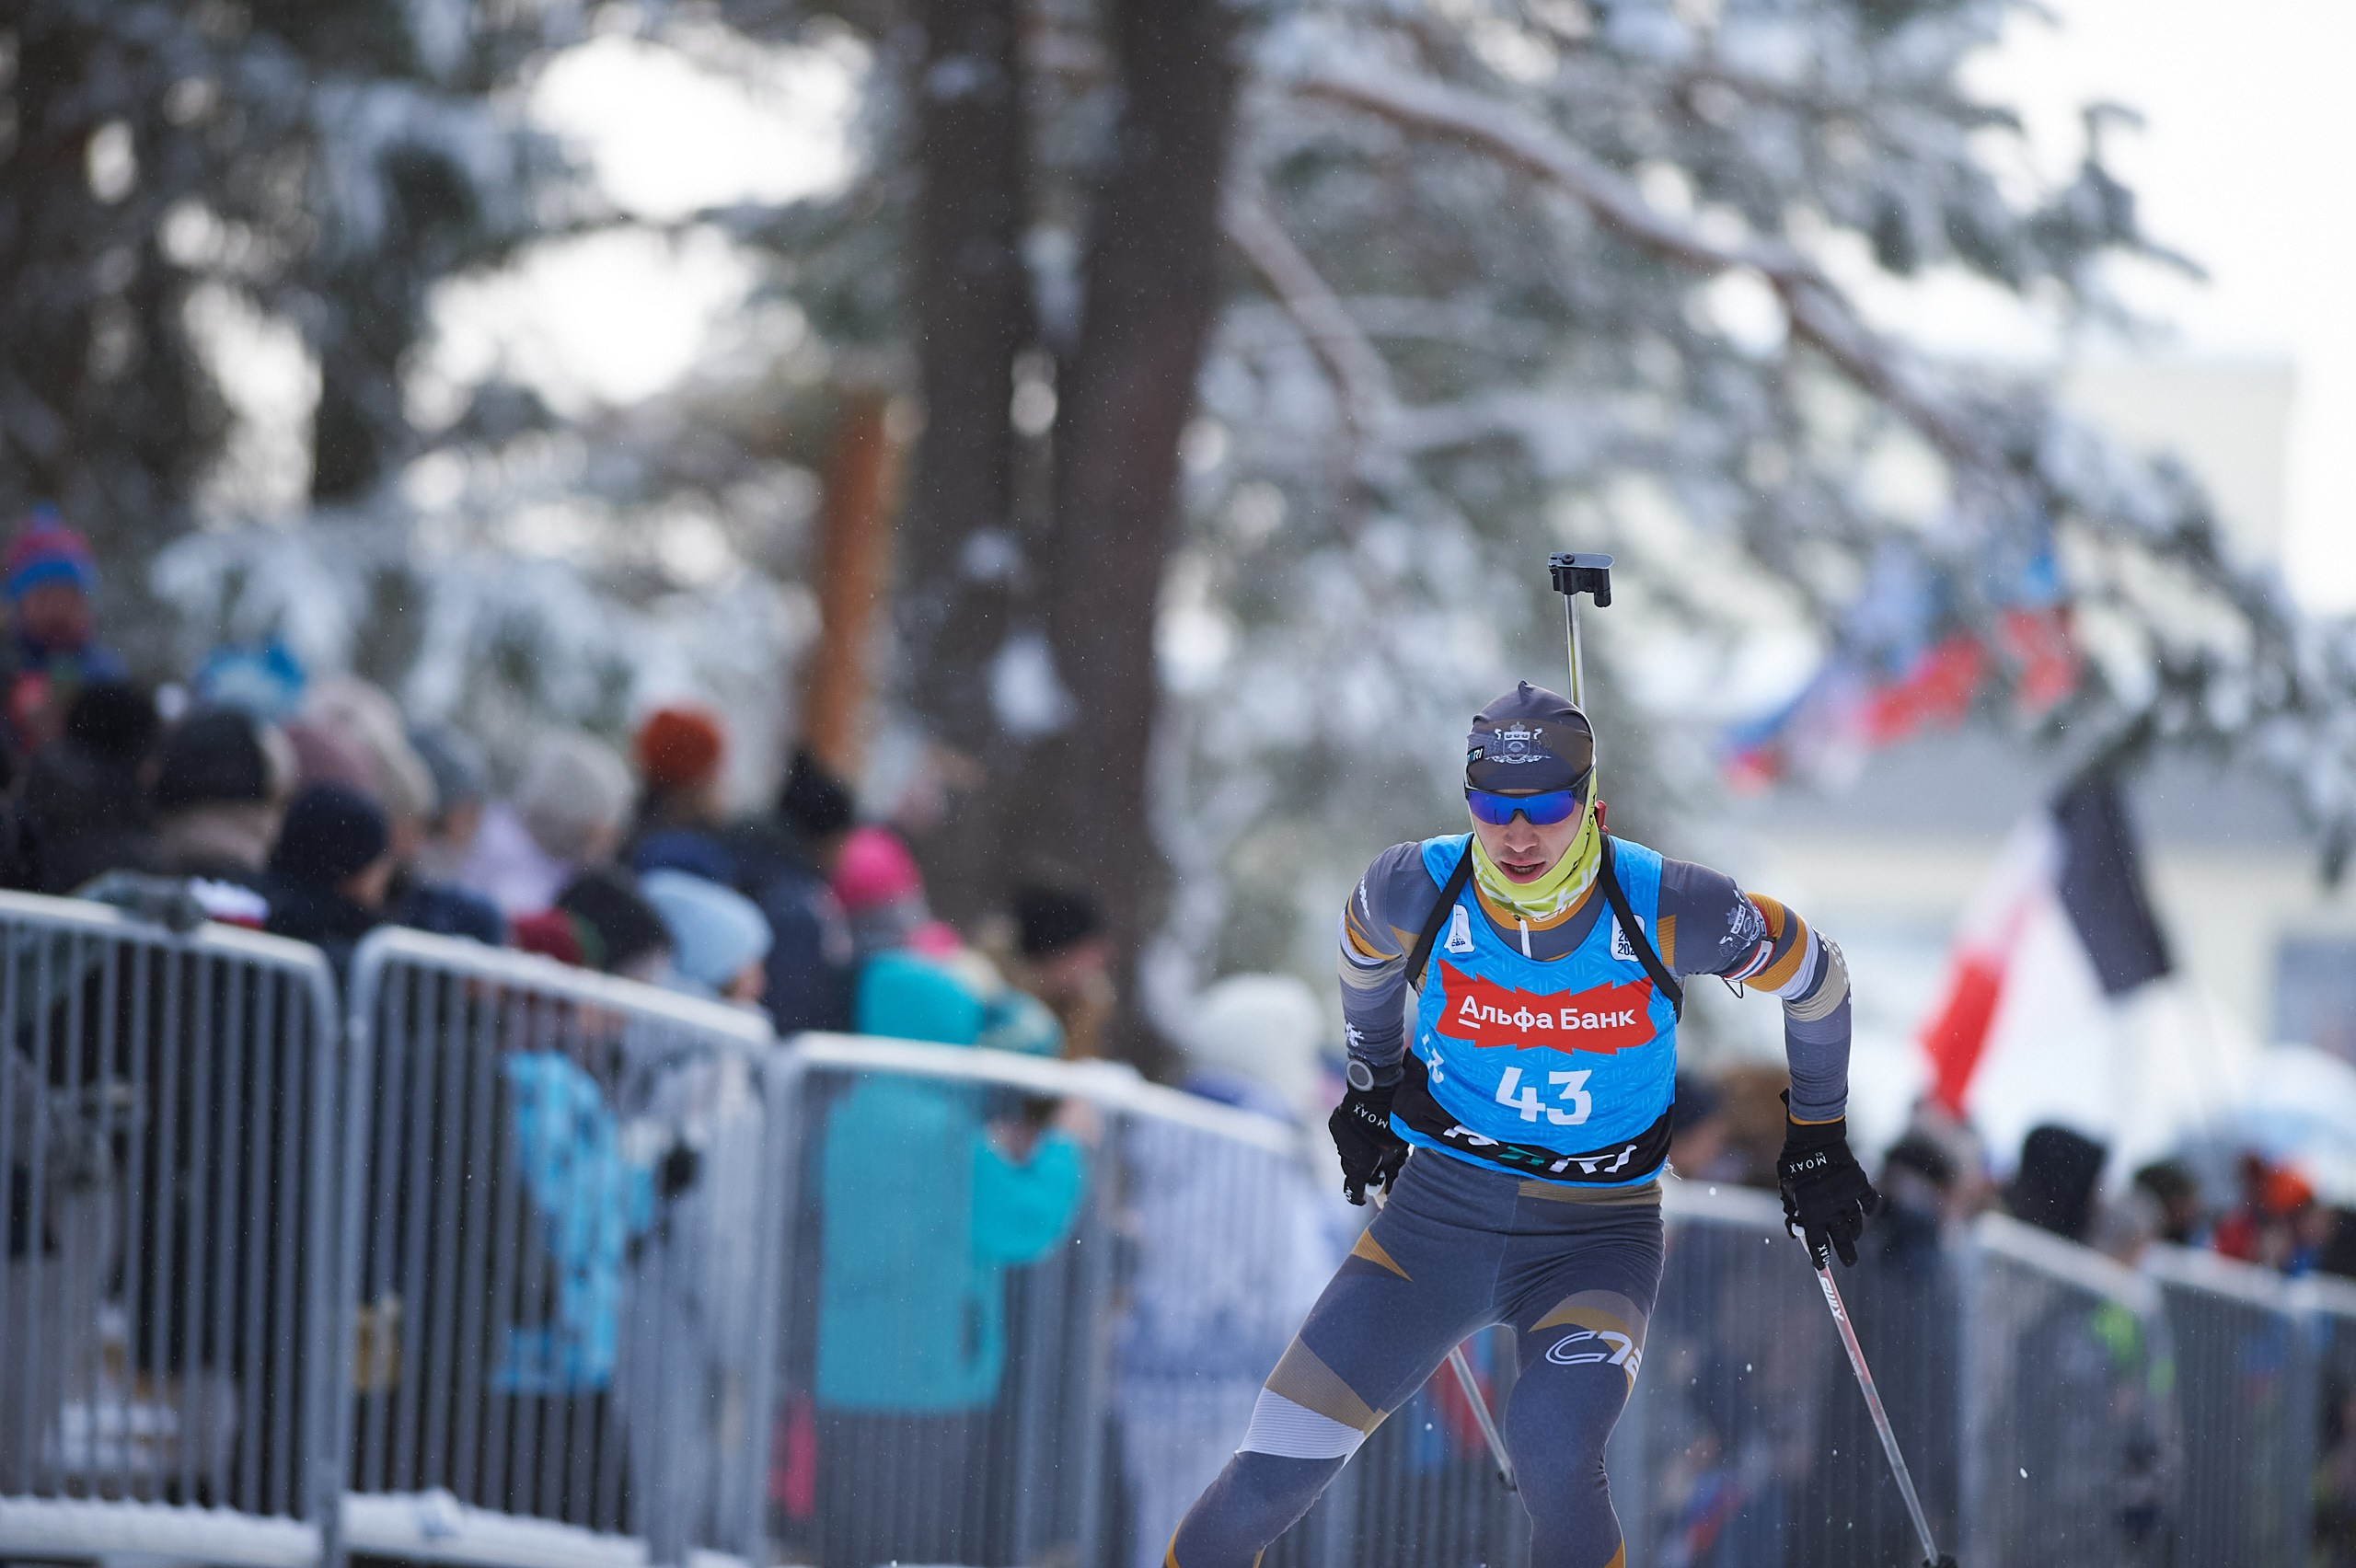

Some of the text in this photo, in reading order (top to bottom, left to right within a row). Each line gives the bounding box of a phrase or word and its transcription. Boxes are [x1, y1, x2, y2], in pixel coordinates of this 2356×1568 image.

[1459, 995, 1637, 1032] Альфа Банк
[1496, 1066, 1592, 1125] 43
[1353, 1104, 1388, 1129] MOAX
[1789, 1156, 1827, 1173] MOAX
